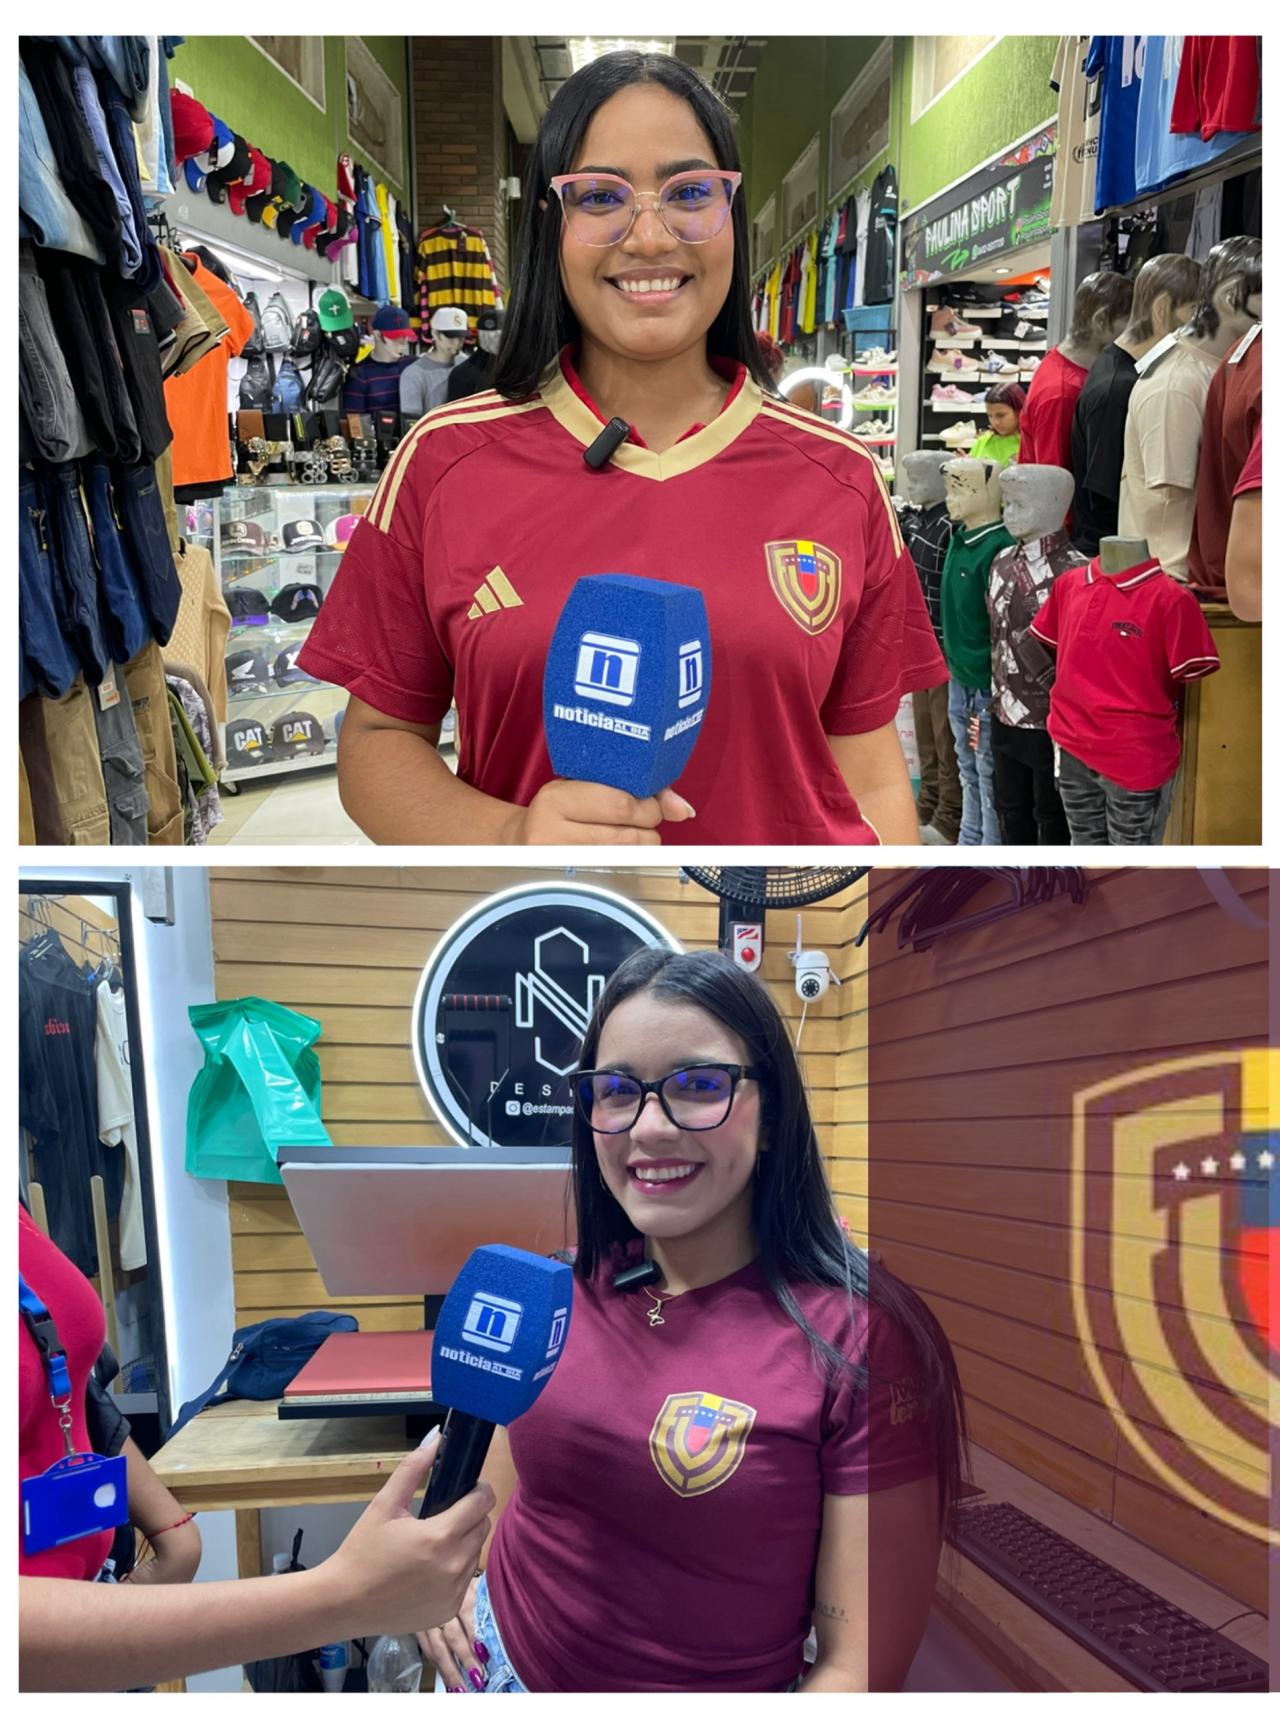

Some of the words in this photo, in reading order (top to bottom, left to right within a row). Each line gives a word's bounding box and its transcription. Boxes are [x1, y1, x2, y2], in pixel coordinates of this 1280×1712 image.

[925, 204, 969, 256] PAULINA
[971, 175, 1021, 234] SPORT
[554, 703, 614, 731] noticia
[233, 728, 263, 751] CAT
[283, 720, 313, 742] CAT
[440, 1346, 492, 1372] noticia
